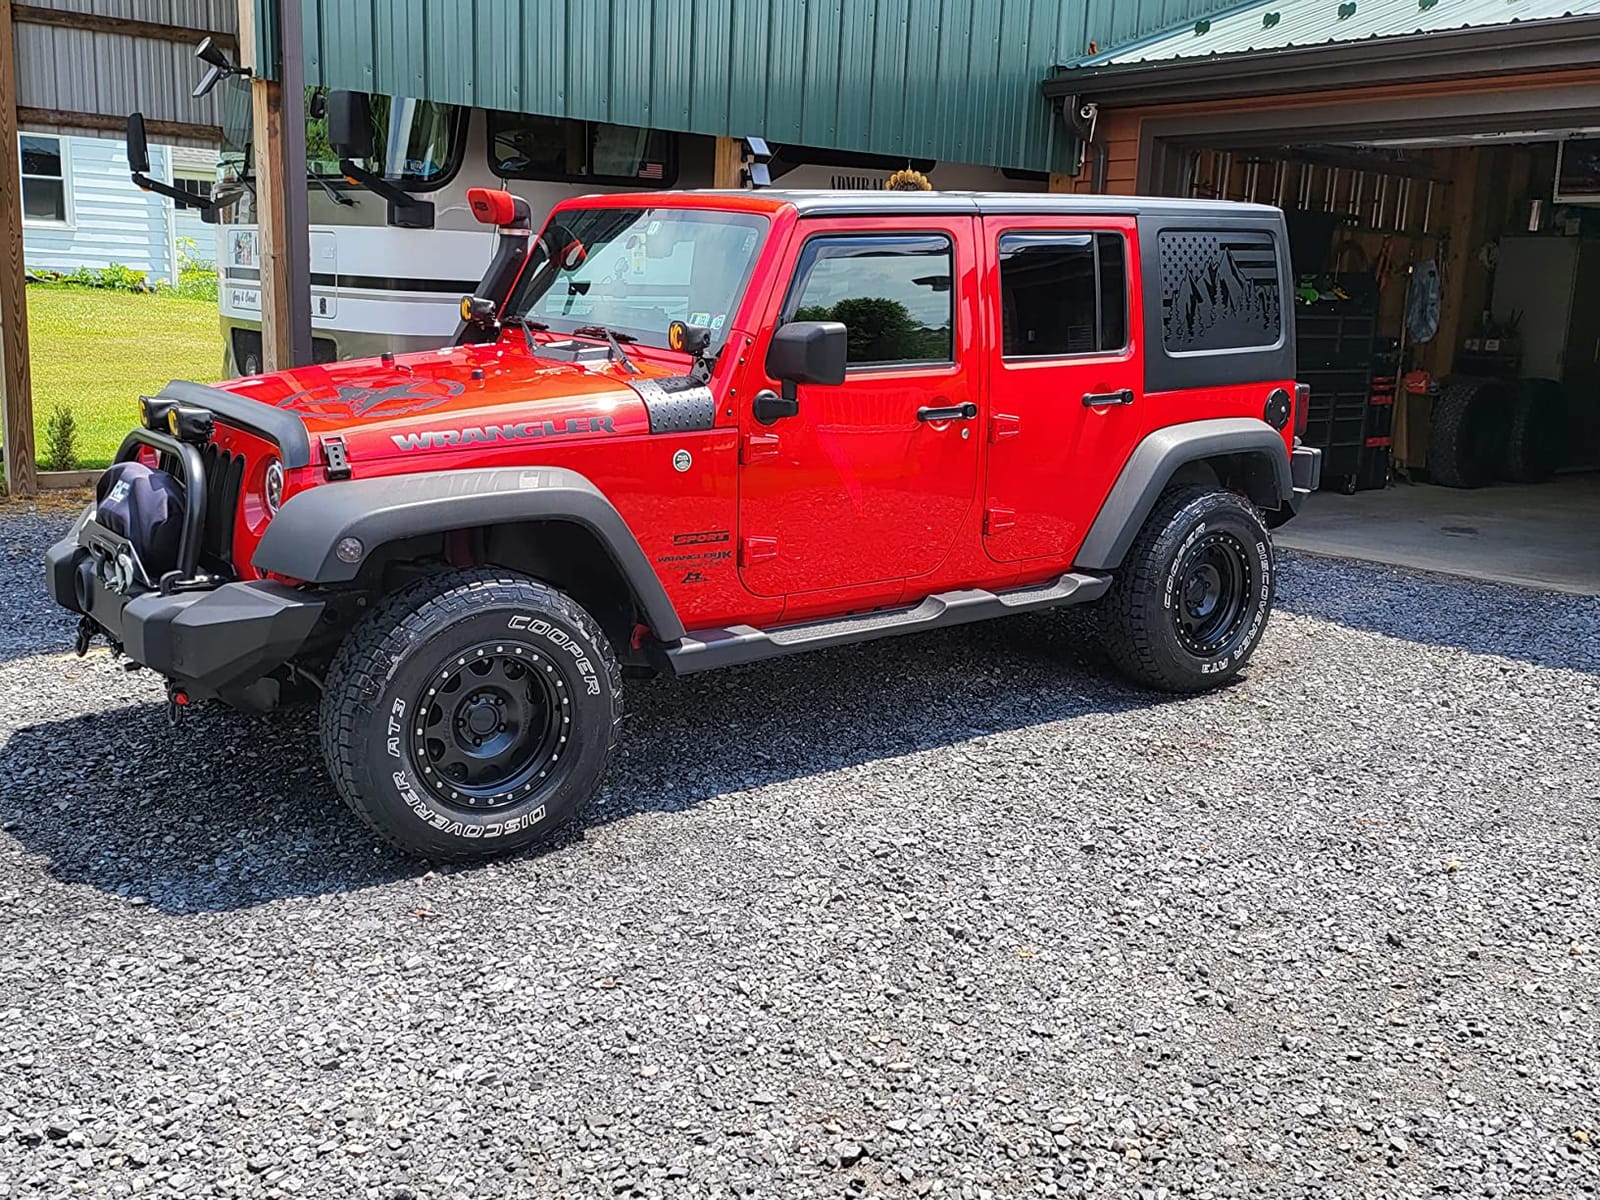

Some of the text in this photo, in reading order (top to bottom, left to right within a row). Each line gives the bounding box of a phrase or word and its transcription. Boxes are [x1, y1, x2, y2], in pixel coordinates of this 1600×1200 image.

[670, 323, 683, 351] KC
[391, 415, 617, 450] WRANGLER
[674, 531, 730, 546] SPORT
[1164, 522, 1206, 609] COOPER
[1201, 541, 1270, 674] DISCOVERER AT3
[507, 615, 600, 696] COOPER
[387, 698, 546, 838] DISCOVERER AT3
